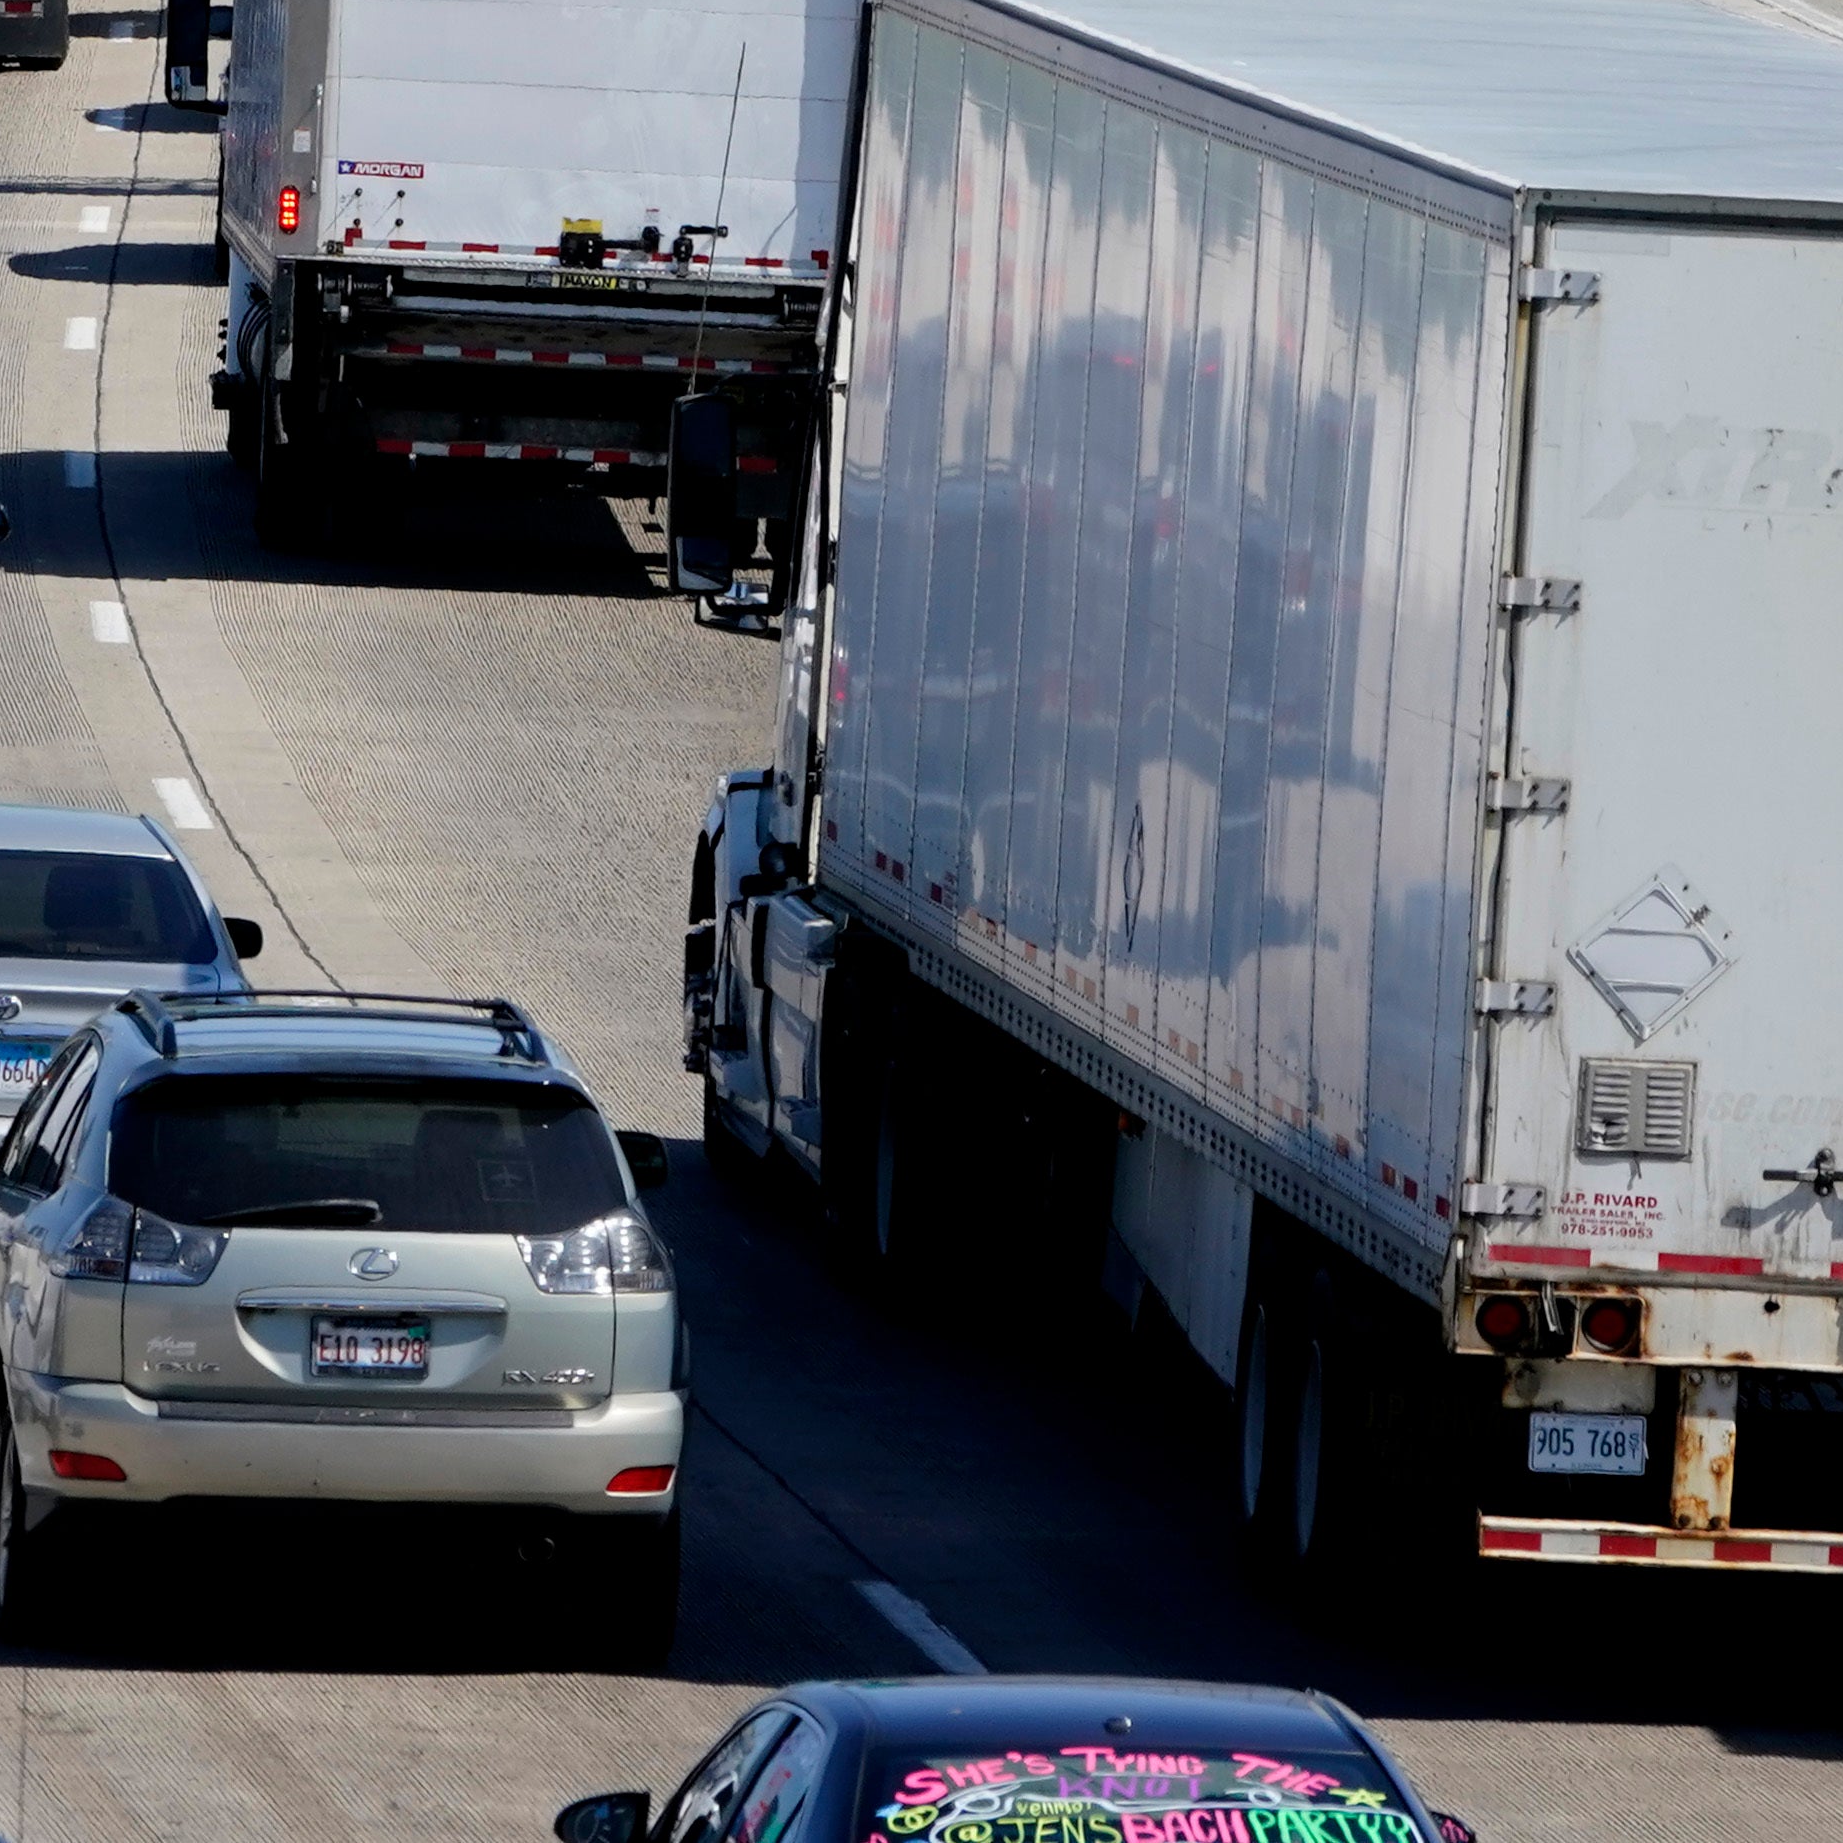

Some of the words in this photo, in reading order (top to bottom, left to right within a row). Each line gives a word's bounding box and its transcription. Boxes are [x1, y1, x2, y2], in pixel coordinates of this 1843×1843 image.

[353, 162, 423, 178] MORGAN
[1560, 1192, 1588, 1205] J.P.
[1593, 1193, 1658, 1209] RIVARD
[1550, 1206, 1597, 1216] TRAILER
[1599, 1209, 1638, 1220] SALES,
[1644, 1212, 1666, 1221] INC.
[1560, 1223, 1654, 1240] 978-251-9953
[318, 1336, 358, 1365] E10
[369, 1336, 426, 1366] 3198
[1536, 1427, 1574, 1456] 905
[1587, 1429, 1626, 1458] 768
[894, 1751, 1056, 1806] SHE'S
[1060, 1746, 1205, 1776] TYING
[1231, 1753, 1341, 1797] THE
